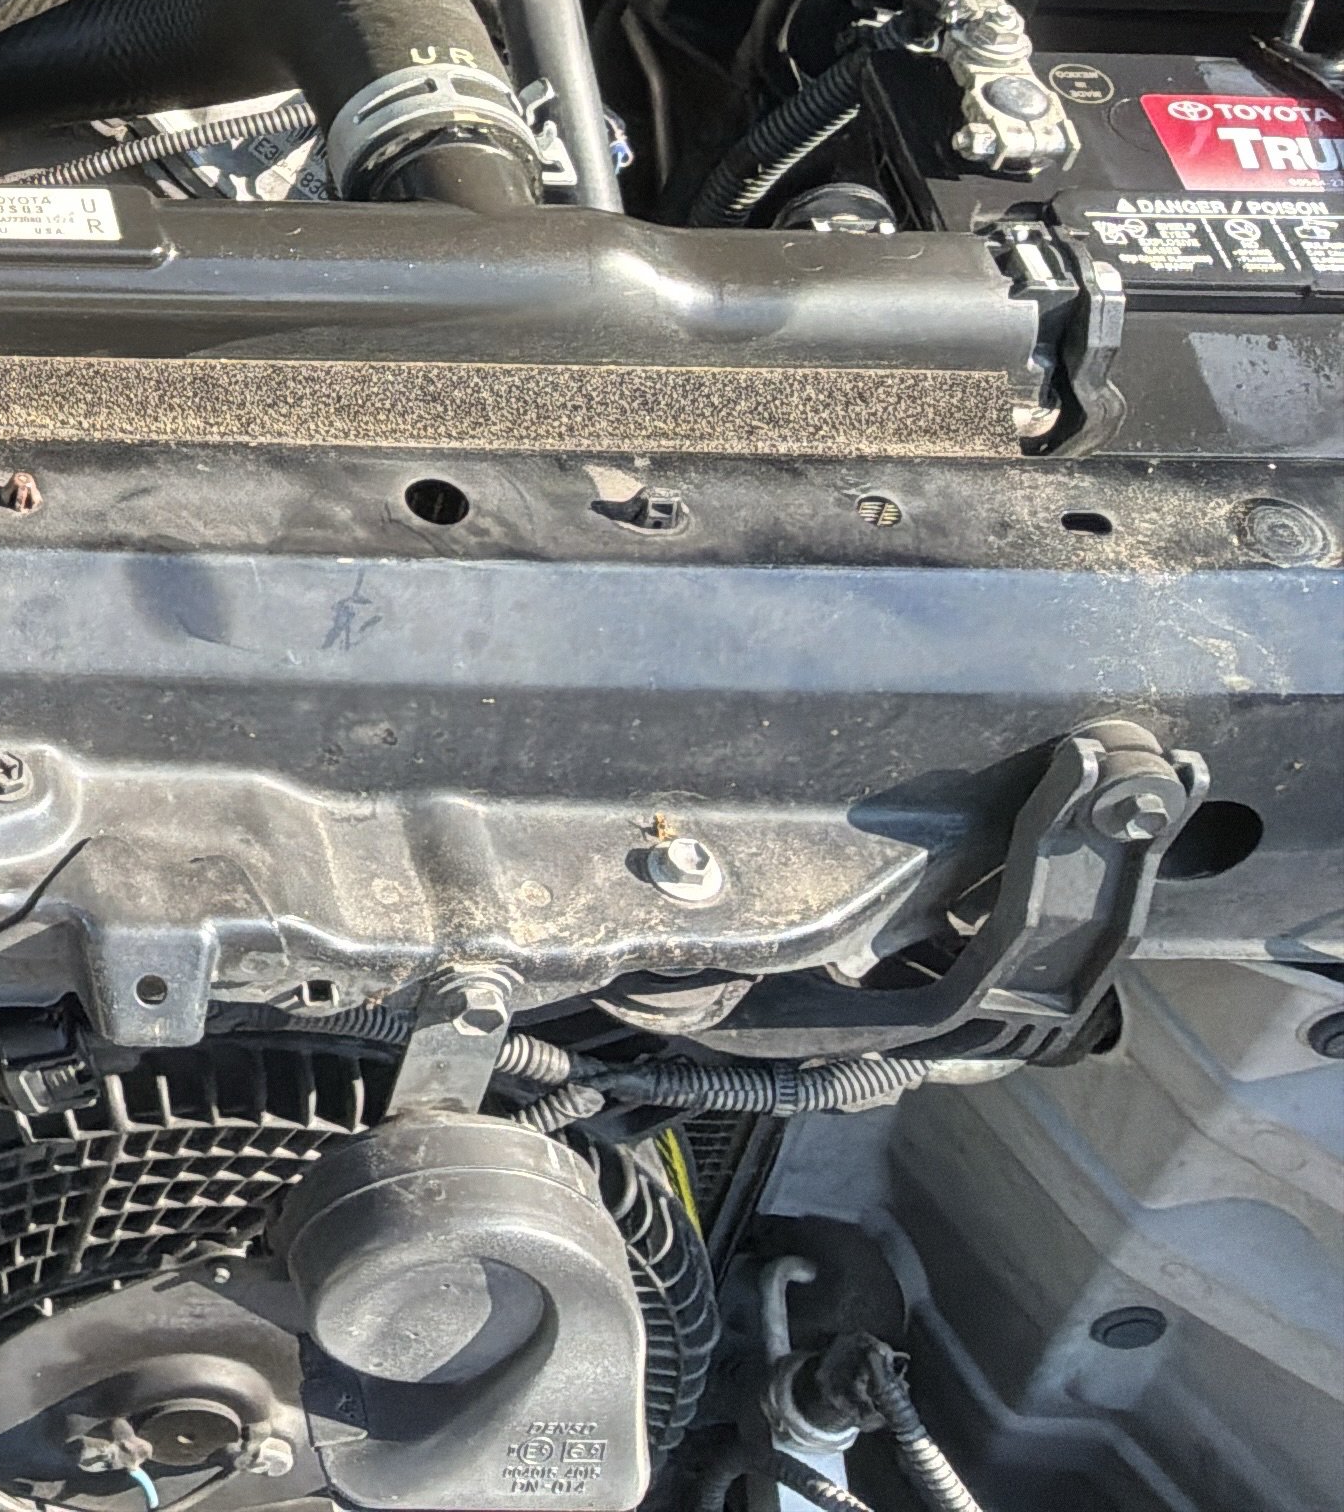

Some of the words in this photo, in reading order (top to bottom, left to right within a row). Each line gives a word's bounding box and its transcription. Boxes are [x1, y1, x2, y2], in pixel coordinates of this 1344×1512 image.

[1213, 102, 1337, 123] TOYOTA
[1216, 127, 1344, 171] TRU
[1135, 198, 1228, 215] DANGER
[1245, 199, 1330, 216] POISON
[526, 1420, 598, 1435] DENSO
